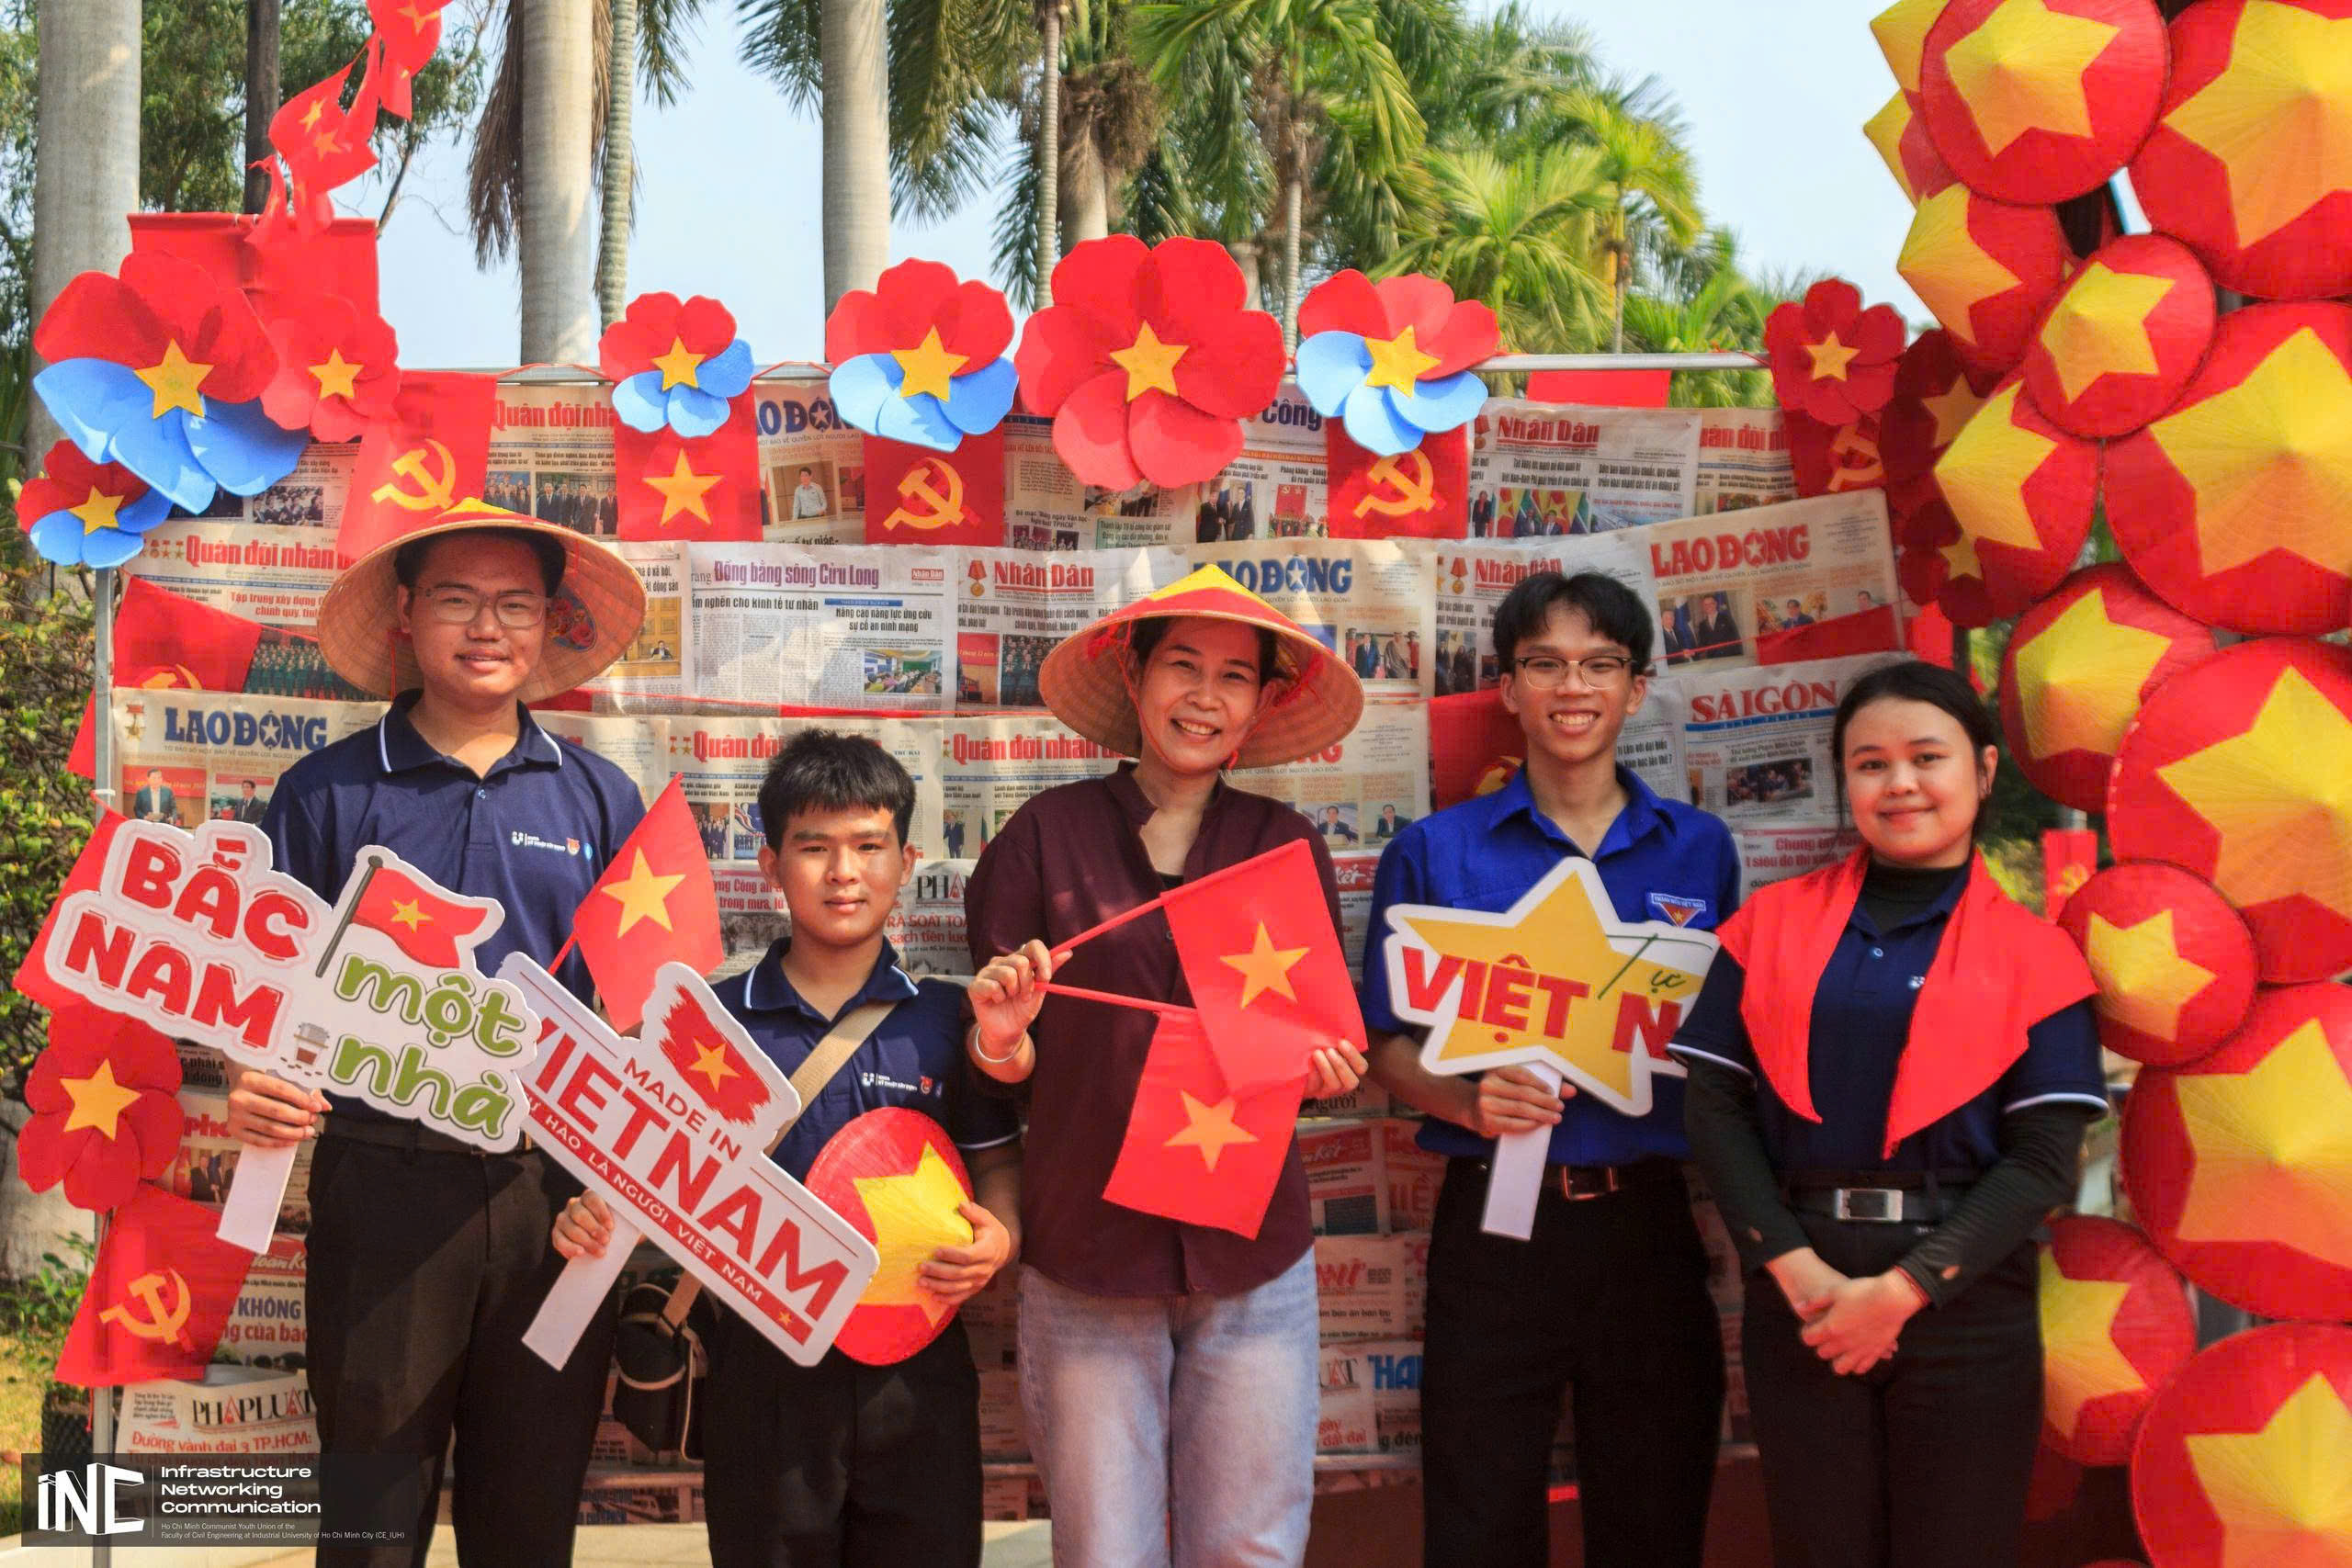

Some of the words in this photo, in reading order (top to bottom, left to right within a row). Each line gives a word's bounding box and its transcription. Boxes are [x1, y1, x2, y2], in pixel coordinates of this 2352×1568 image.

[548, 401, 581, 431] đội
[1261, 398, 1323, 432] Công
[1498, 415, 1555, 441] Nhân
[1556, 419, 1601, 443] Dân
[1700, 424, 1735, 447] uân
[187, 535, 242, 567] Quân
[244, 539, 277, 570] đội
[280, 542, 334, 570] nhân
[1650, 536, 1715, 579] LAO
[691, 571, 711, 584] rang
[714, 558, 747, 585] Đồng
[751, 559, 782, 587] bằng
[785, 562, 816, 589] sông
[820, 561, 847, 585] Cửu
[850, 564, 879, 589] Long
[994, 560, 1046, 588] Nhân
[1051, 563, 1094, 588] Dân
[733, 597, 749, 608] cho
[752, 596, 771, 609] kinh
[797, 599, 819, 611] nhân
[856, 609, 869, 618] cao
[870, 623, 879, 631] an
[880, 621, 897, 631] ninh
[899, 622, 919, 633] mạng
[164, 706, 232, 746] LAO
[694, 730, 748, 762] Quân
[953, 733, 1007, 765] Quân
[1010, 733, 1043, 763] đội
[1046, 733, 1099, 760] nhân
[121, 838, 311, 960] BẮC
[734, 878, 757, 895] Công
[719, 897, 745, 910] trong
[64, 912, 284, 1049] NAM
[1402, 945, 1591, 1043] VIỆT
[334, 952, 526, 1057] một
[330, 1033, 517, 1141] nhà
[624, 1056, 708, 1135] MADE
[709, 1126, 742, 1162] IN
[545, 1117, 582, 1153] HÀO
[588, 1151, 610, 1176] LÀ
[615, 1171, 671, 1230] NGƯỜI
[676, 1224, 718, 1260] VIỆT
[722, 1264, 763, 1303] NAM
[238, 1296, 301, 1320] KHÔNG
[244, 1322, 276, 1341] của
[132, 1430, 175, 1452] Đường
[178, 1435, 211, 1452] vành
[215, 1437, 237, 1452] đai
[252, 1430, 312, 1451] TP.HCM:
